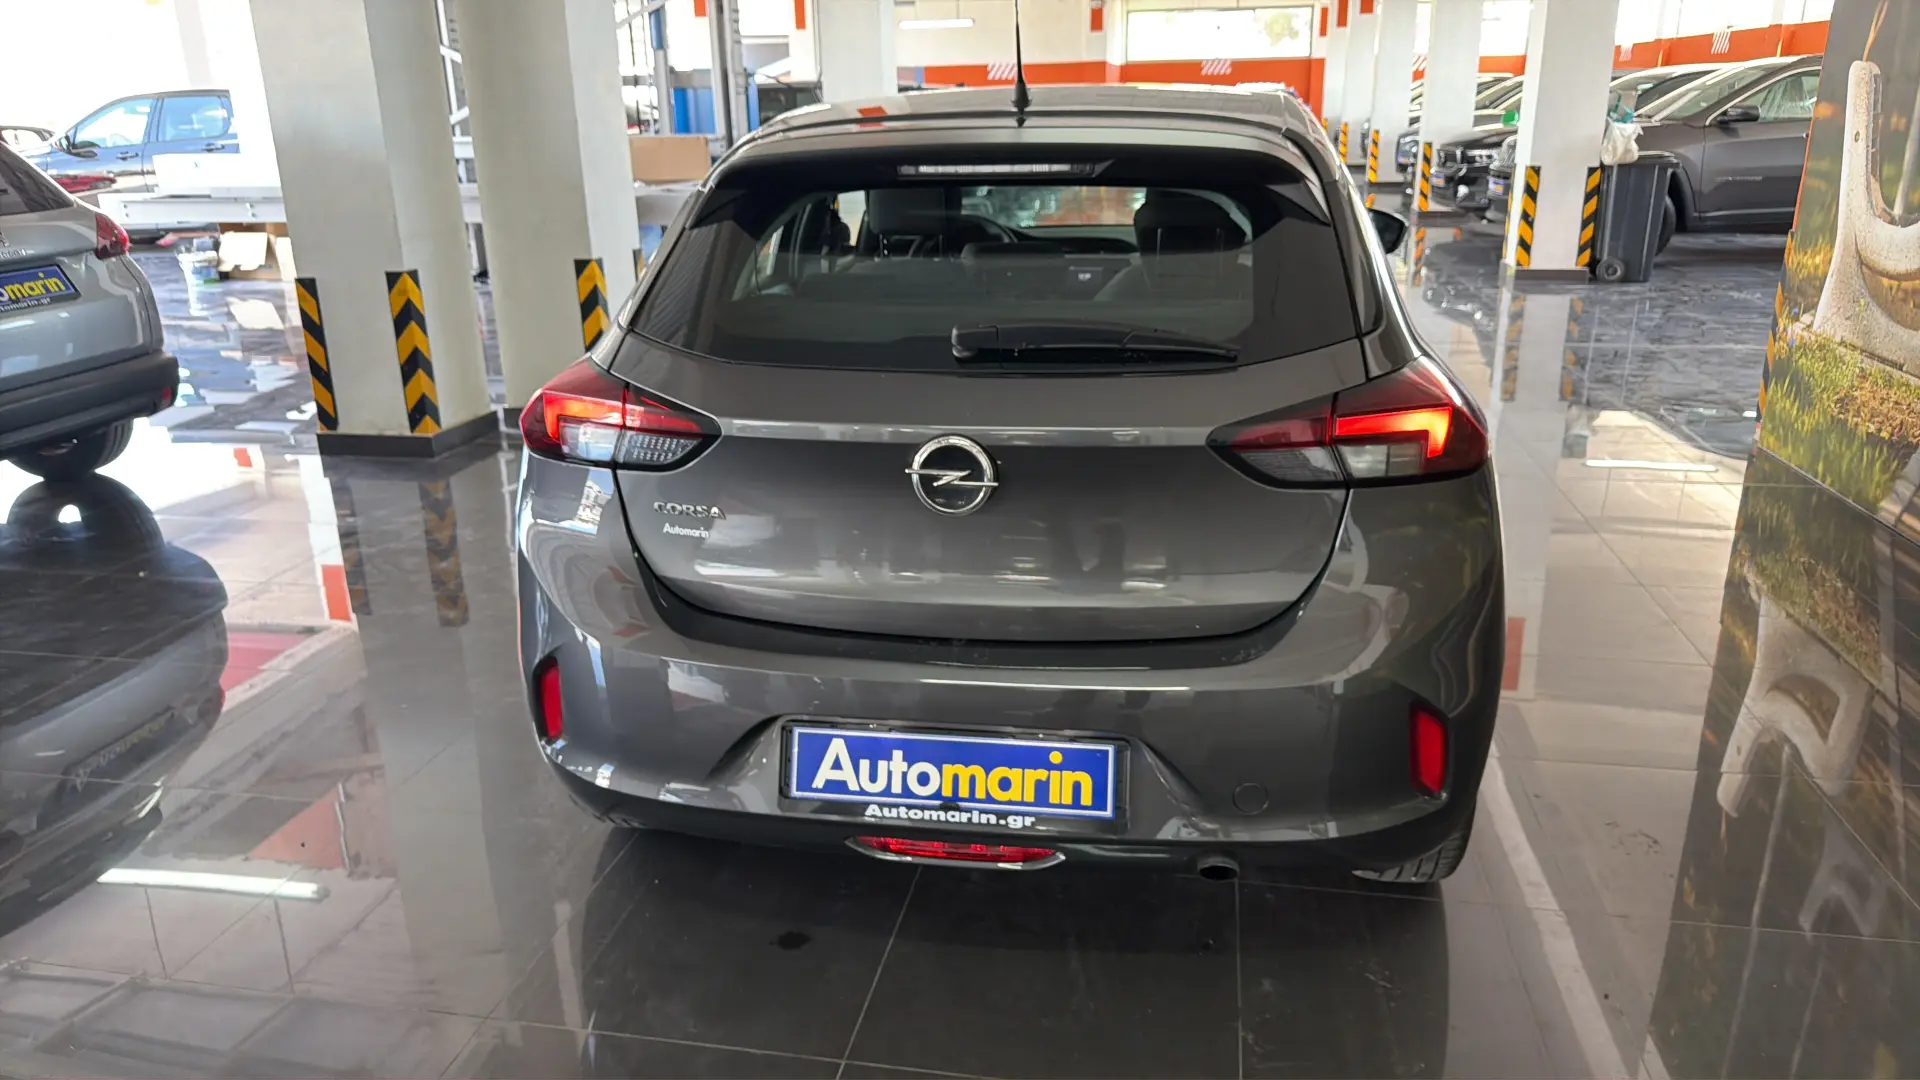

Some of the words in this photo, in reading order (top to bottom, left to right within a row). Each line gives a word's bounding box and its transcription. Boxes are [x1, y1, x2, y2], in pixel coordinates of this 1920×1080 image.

[653, 501, 726, 520] CORSA
[663, 522, 709, 538] Automarin
[811, 737, 1093, 806] Automarin
[865, 803, 1035, 829] Automarin.gr
